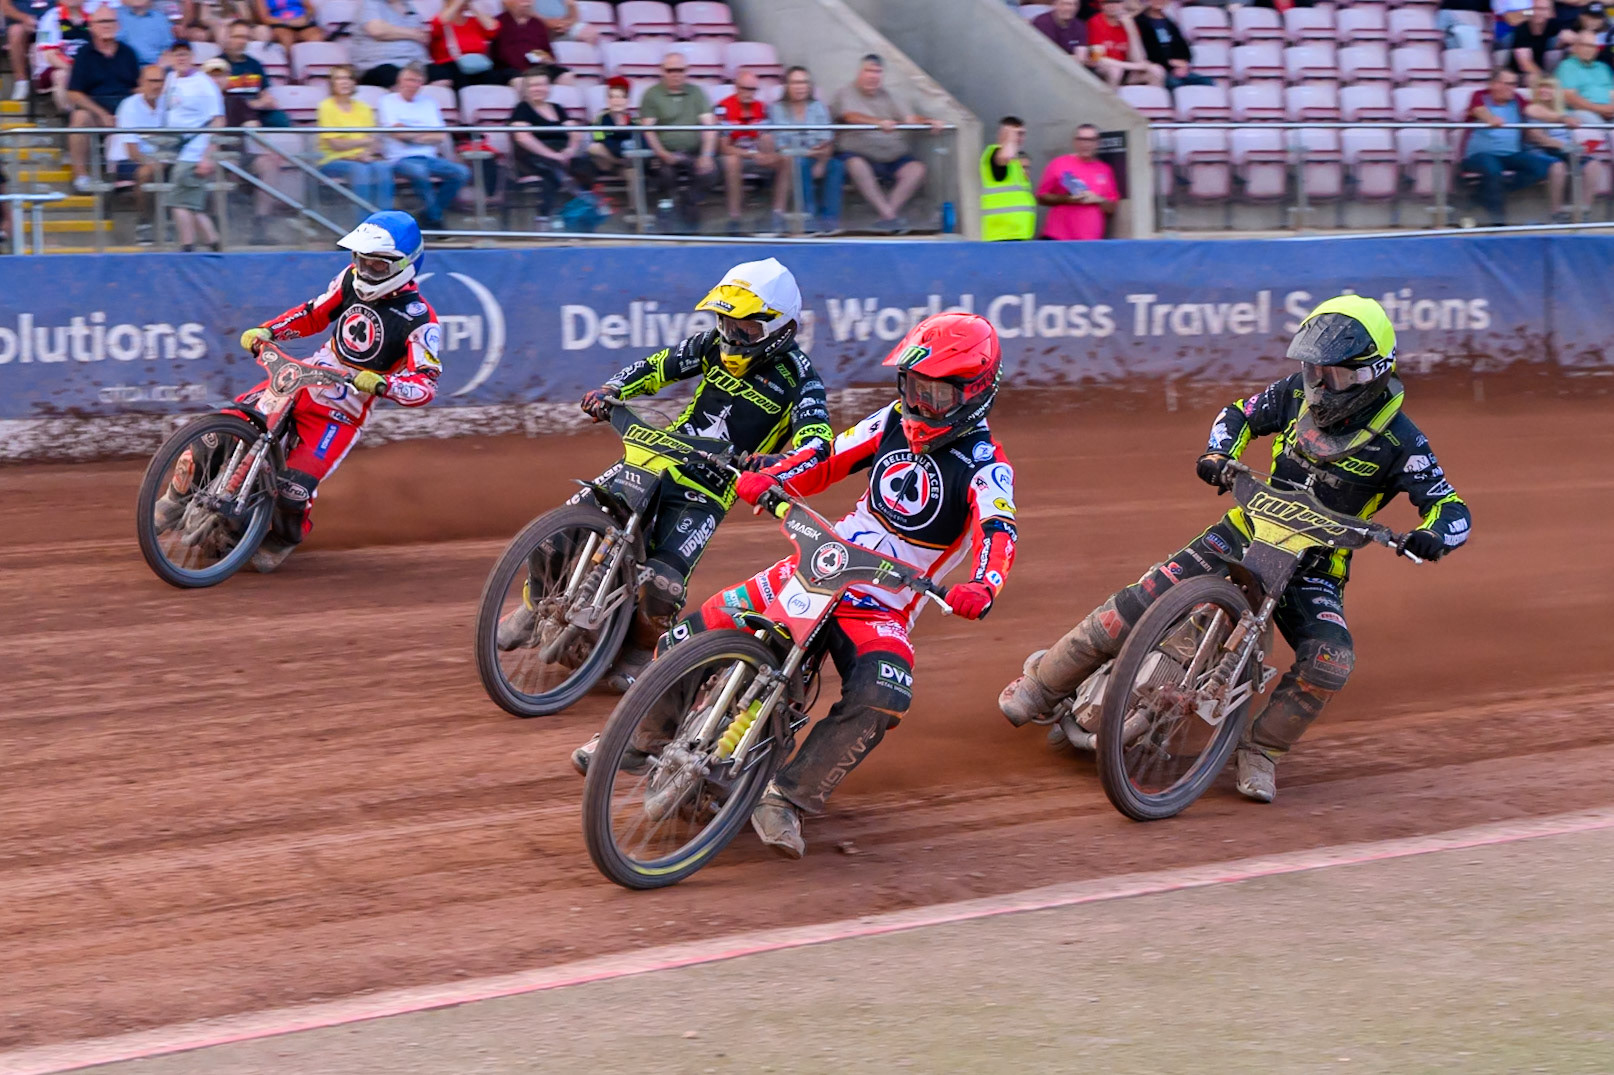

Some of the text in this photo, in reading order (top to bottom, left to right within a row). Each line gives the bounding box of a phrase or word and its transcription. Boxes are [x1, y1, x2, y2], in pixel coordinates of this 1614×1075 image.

[987, 292, 1116, 339] Class
[1126, 289, 1272, 337] Travel
[883, 453, 913, 467] BELLE
[914, 454, 932, 470] VUE
[929, 472, 940, 500] ACES
[791, 520, 822, 541] MAGIK
